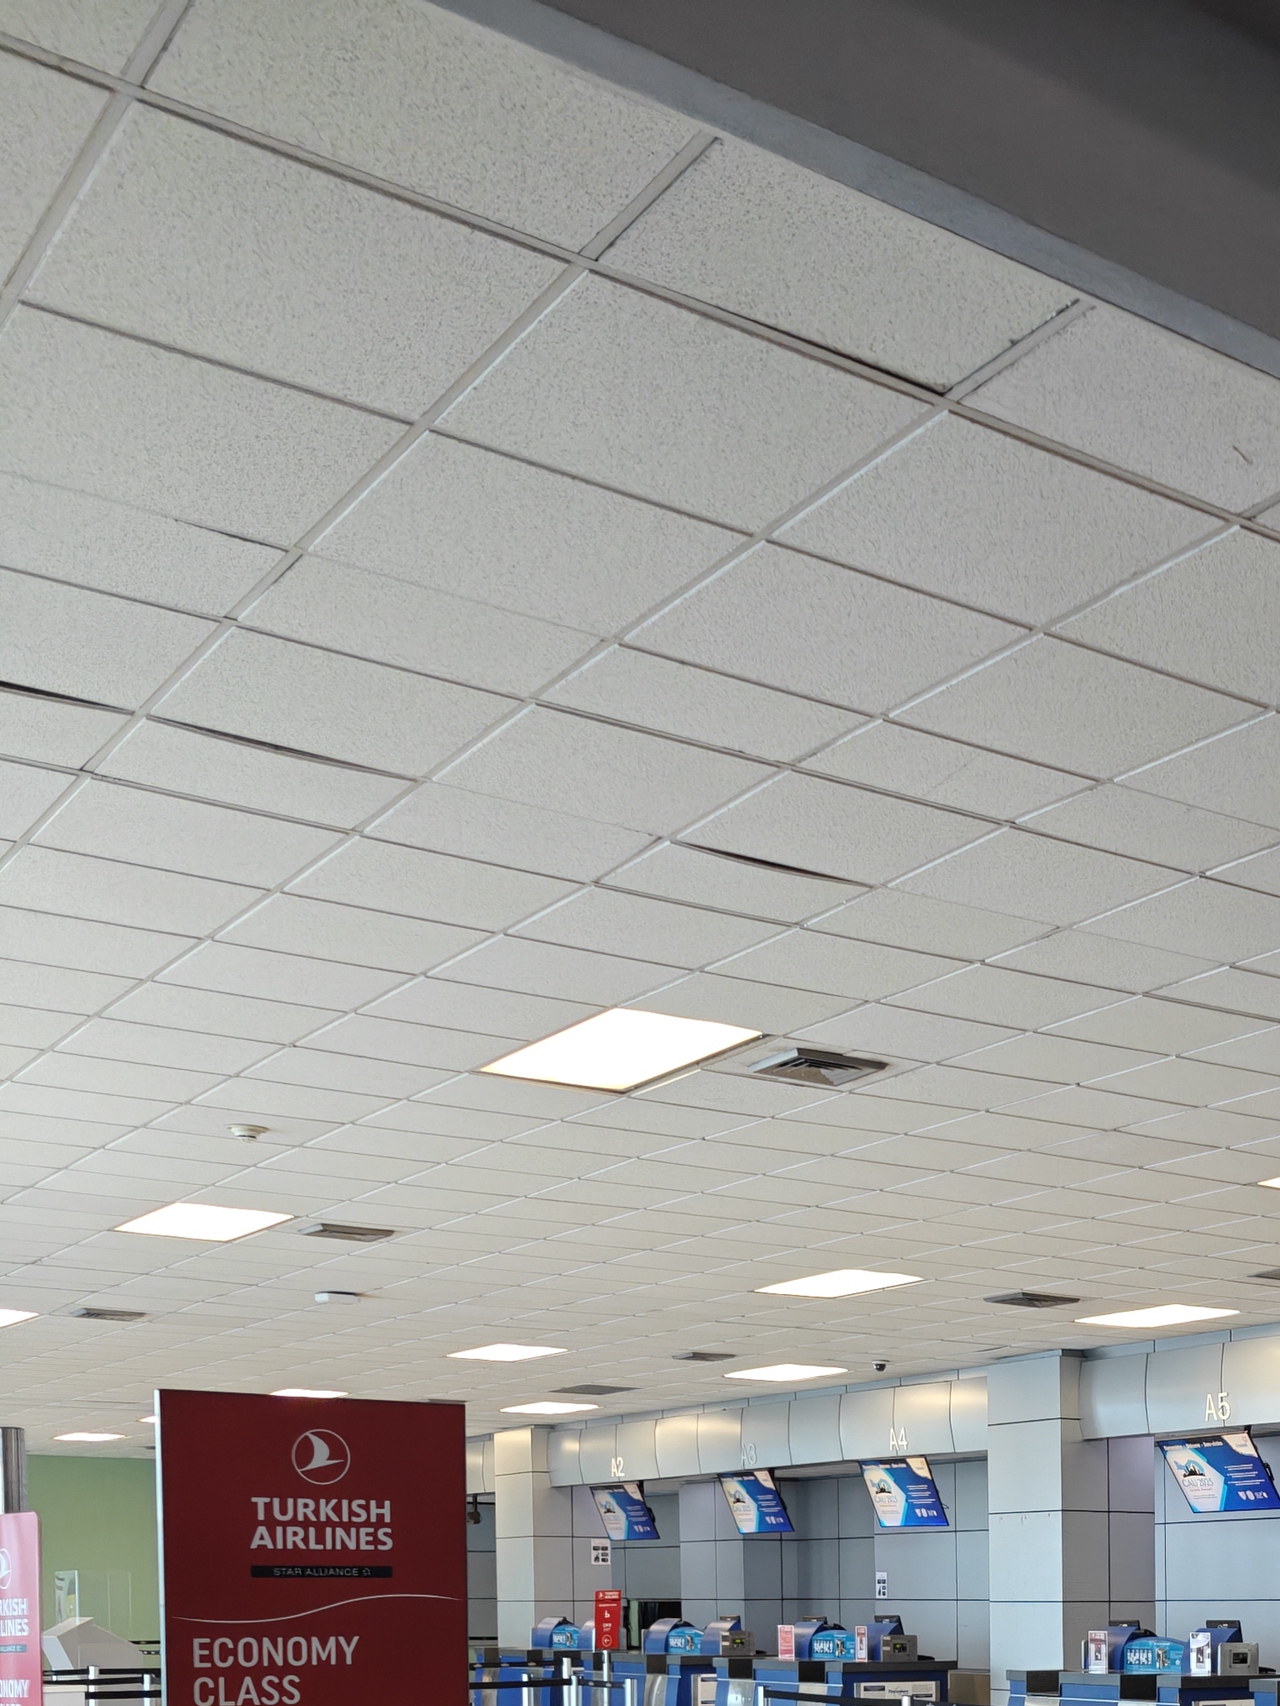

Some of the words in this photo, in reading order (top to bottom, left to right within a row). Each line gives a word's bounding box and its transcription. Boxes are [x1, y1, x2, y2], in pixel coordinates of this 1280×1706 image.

[1205, 1391, 1231, 1421] A5
[890, 1427, 908, 1451] A4
[741, 1443, 757, 1465] A3
[611, 1456, 625, 1477] A2
[251, 1497, 391, 1522] TURKISH
[250, 1526, 394, 1550] AIRLINES
[273, 1567, 302, 1576] STAR
[305, 1567, 359, 1576] ALLIANCE
[193, 1635, 360, 1668] ECONOMY
